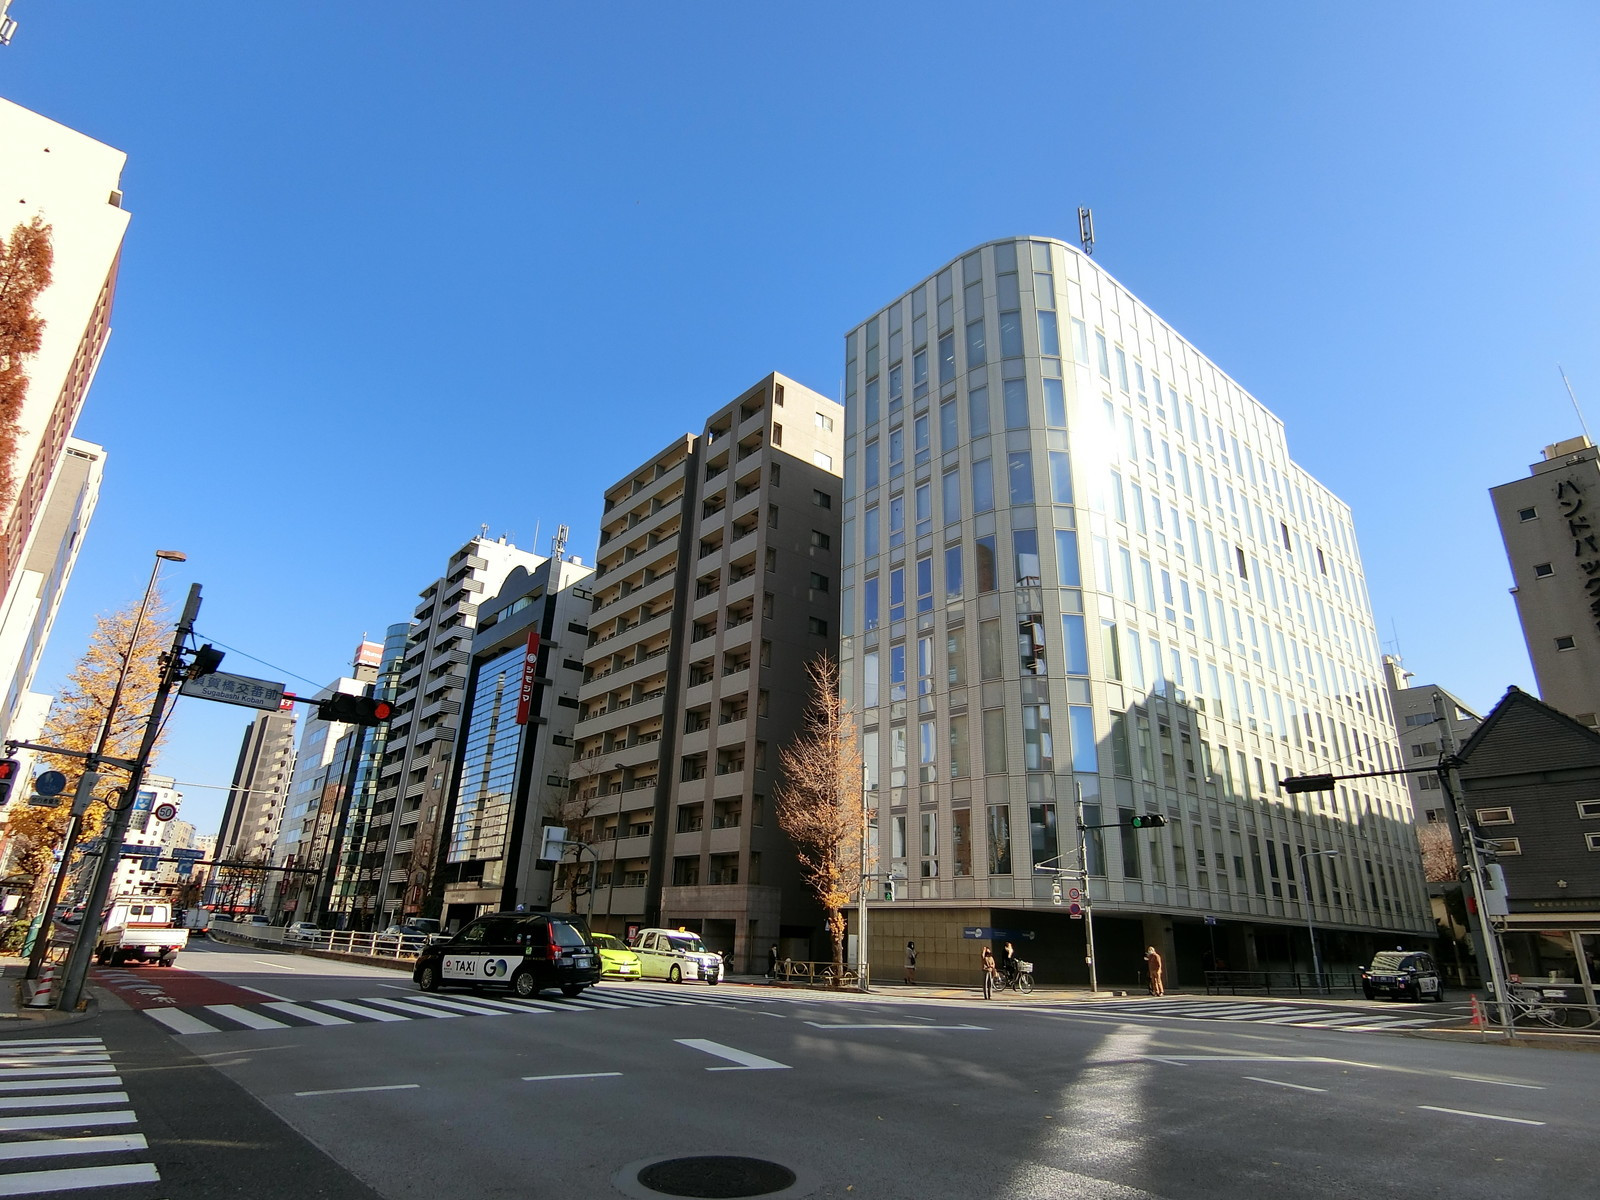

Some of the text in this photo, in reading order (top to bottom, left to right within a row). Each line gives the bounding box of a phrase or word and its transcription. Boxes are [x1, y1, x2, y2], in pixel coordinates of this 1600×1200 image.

[202, 687, 264, 705] Sugabashi Koban
[159, 807, 172, 818] 50
[455, 958, 508, 977] TAXI GO
